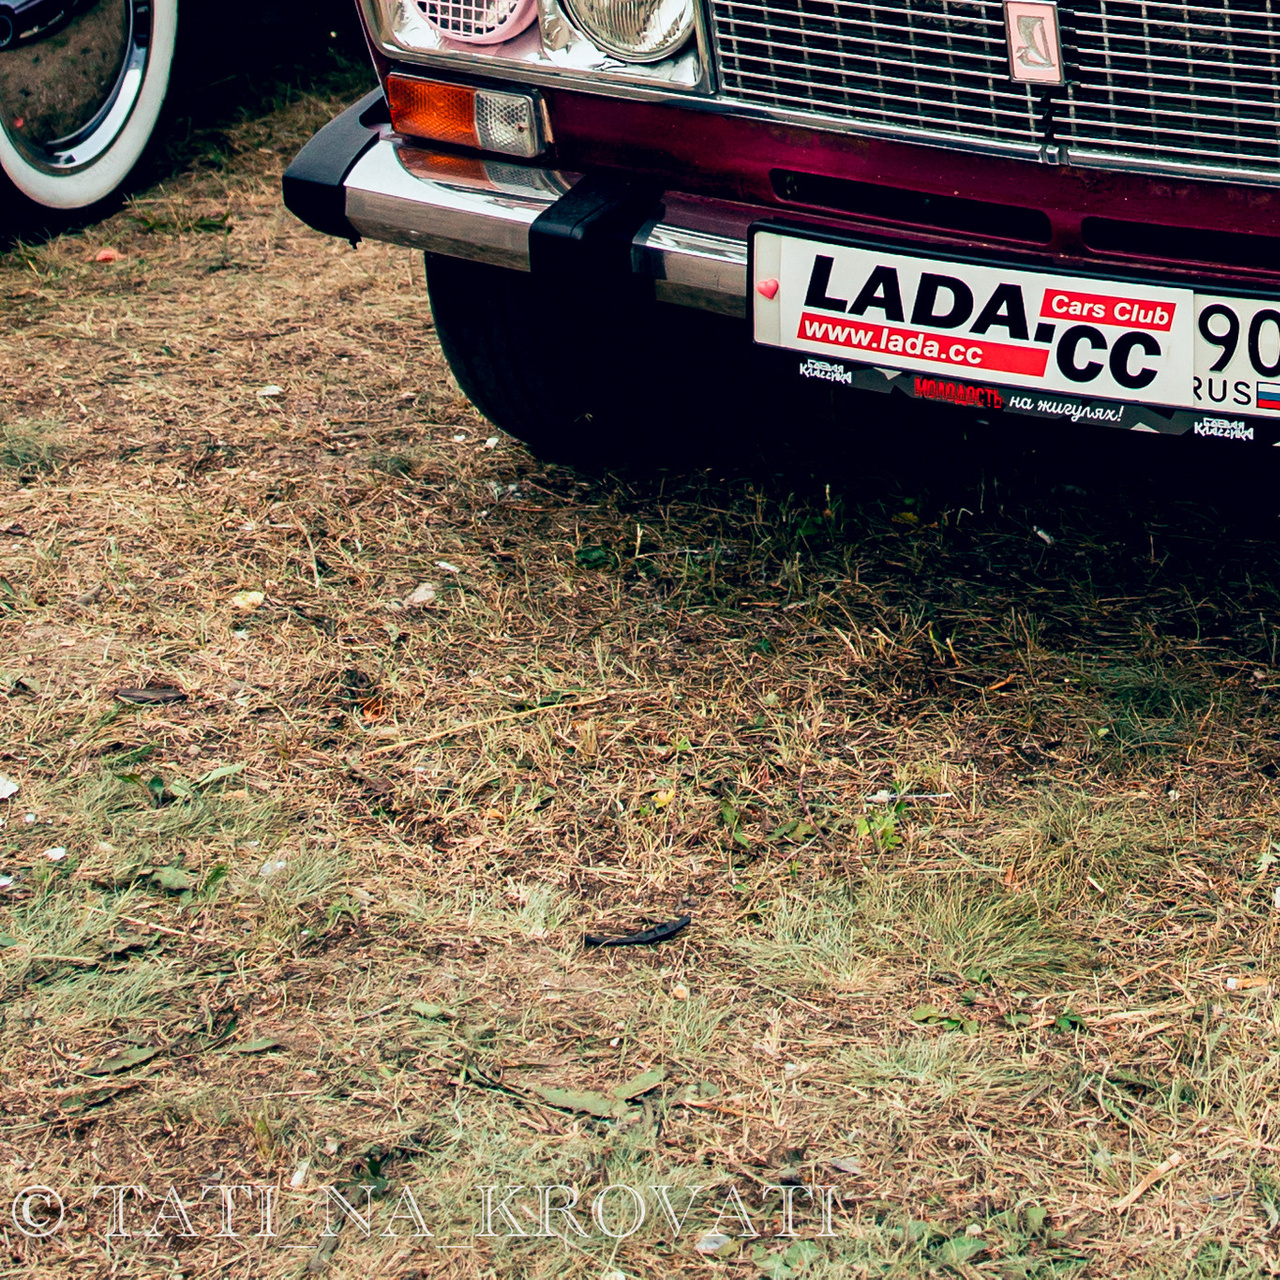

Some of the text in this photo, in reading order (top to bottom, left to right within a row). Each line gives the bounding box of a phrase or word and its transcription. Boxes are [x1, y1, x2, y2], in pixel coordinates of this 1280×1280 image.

[1050, 295, 1170, 326] Cars Club
[804, 319, 984, 366] www.lada.cc
[914, 376, 1125, 422] МОЛОДОСТЬ на жигулях!
[1194, 376, 1252, 406] RUS
